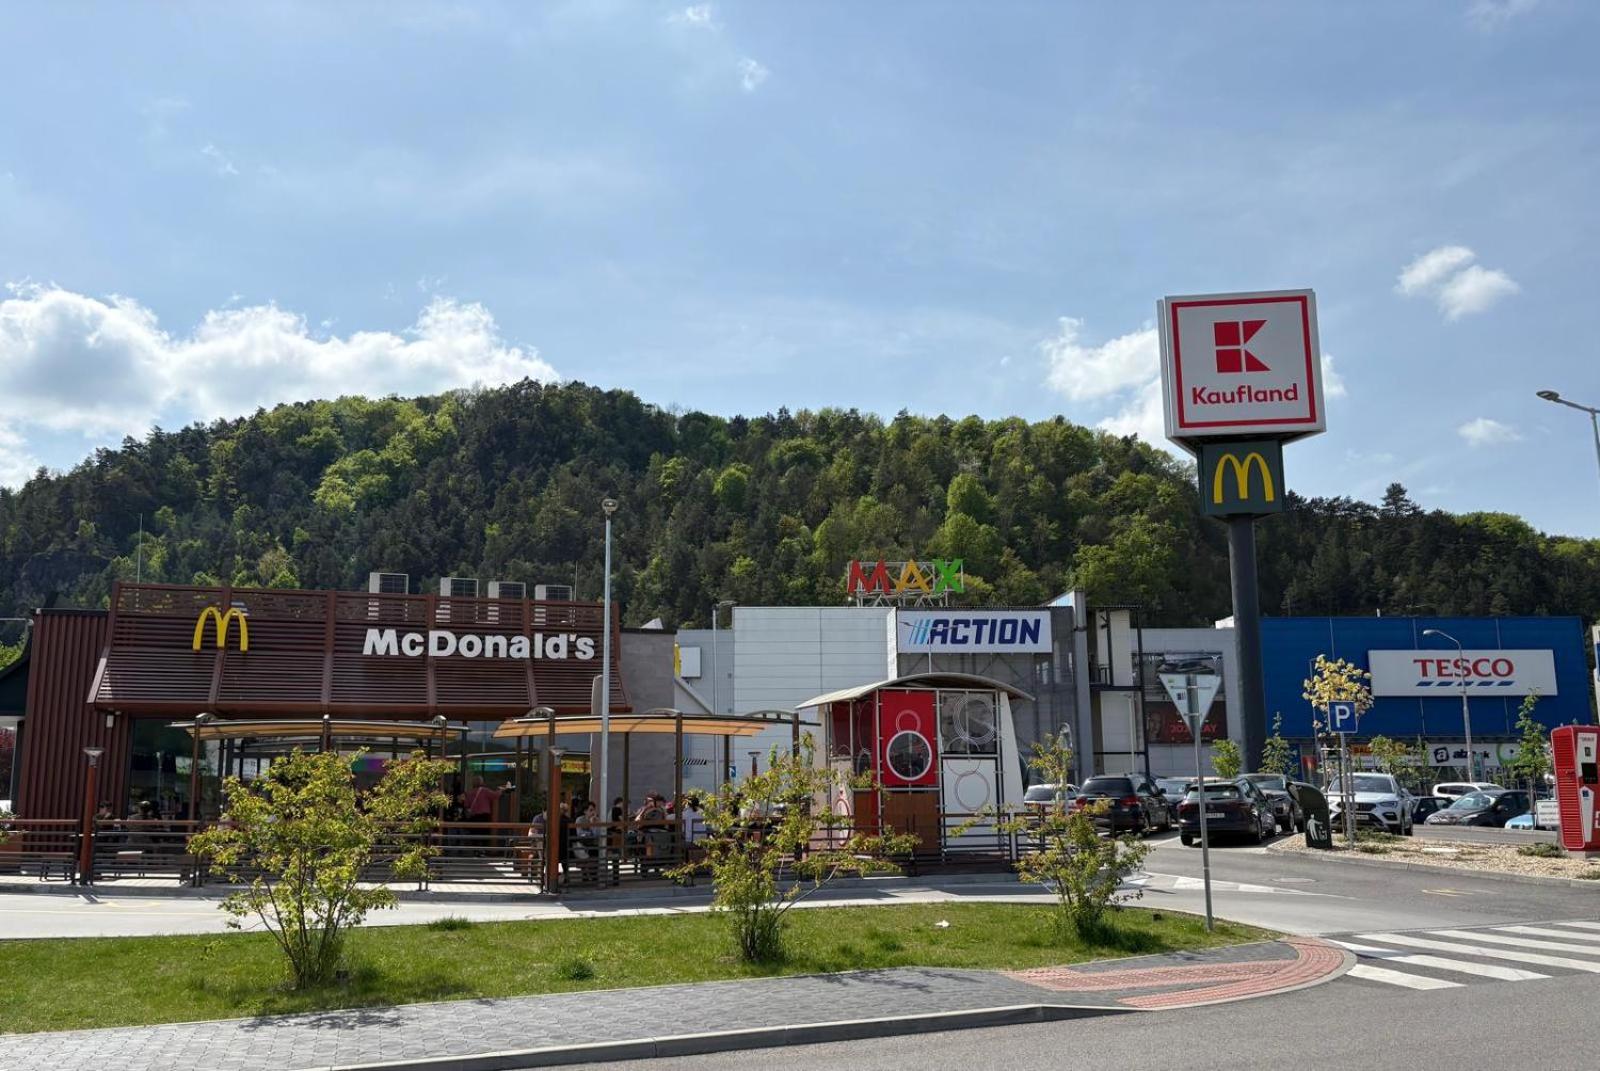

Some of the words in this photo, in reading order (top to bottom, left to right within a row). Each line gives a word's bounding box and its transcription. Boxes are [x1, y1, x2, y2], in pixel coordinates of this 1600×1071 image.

[1191, 383, 1299, 405] Kaufland
[848, 558, 964, 593] MAX
[362, 628, 595, 660] McDonald's
[927, 618, 1042, 645] ACTION
[1413, 657, 1515, 678] TESCO
[1335, 704, 1351, 728] P
